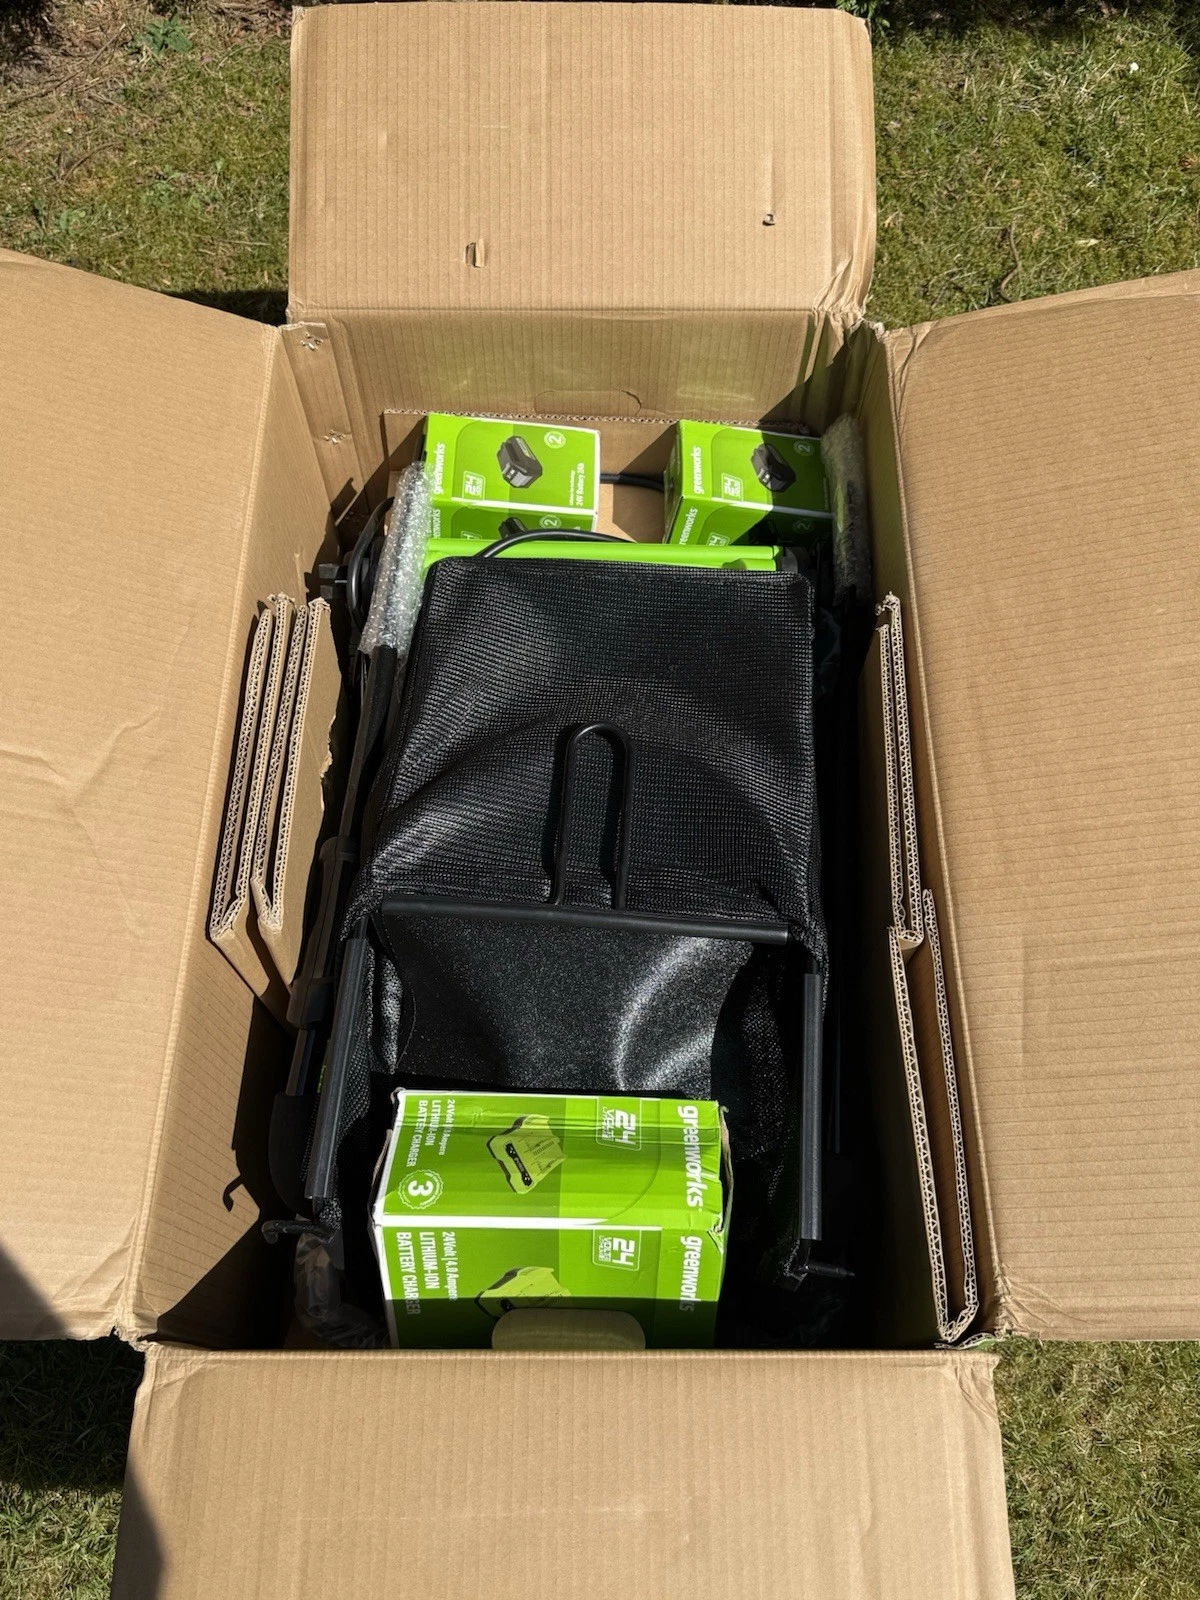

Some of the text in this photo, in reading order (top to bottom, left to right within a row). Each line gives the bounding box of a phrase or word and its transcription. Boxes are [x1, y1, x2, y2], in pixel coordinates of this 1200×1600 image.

[547, 433, 562, 446] 2
[434, 442, 446, 494] greenworks
[693, 446, 705, 495] greenworks
[464, 474, 477, 495] 24
[723, 477, 735, 495] 24
[543, 517, 558, 529] 2
[678, 507, 699, 545] reenworks
[425, 1100, 441, 1146] LITHIUM-ION
[445, 1099, 455, 1123] 24Volt
[406, 1100, 428, 1167] BATTERY CHARGER
[615, 1109, 636, 1145] 24
[438, 1133, 450, 1155] Ampere
[677, 1105, 708, 1207] greenworks
[407, 1180, 434, 1197] 3
[442, 1231, 457, 1257] 24Volt
[612, 1237, 635, 1266] 24
[396, 1232, 421, 1315] BATTERY CHARGER
[419, 1232, 440, 1289] LITHIUM-ION
[445, 1260, 458, 1273] 4.0
[679, 1235, 703, 1312] greenworks
[445, 1273, 459, 1301] Ampere
